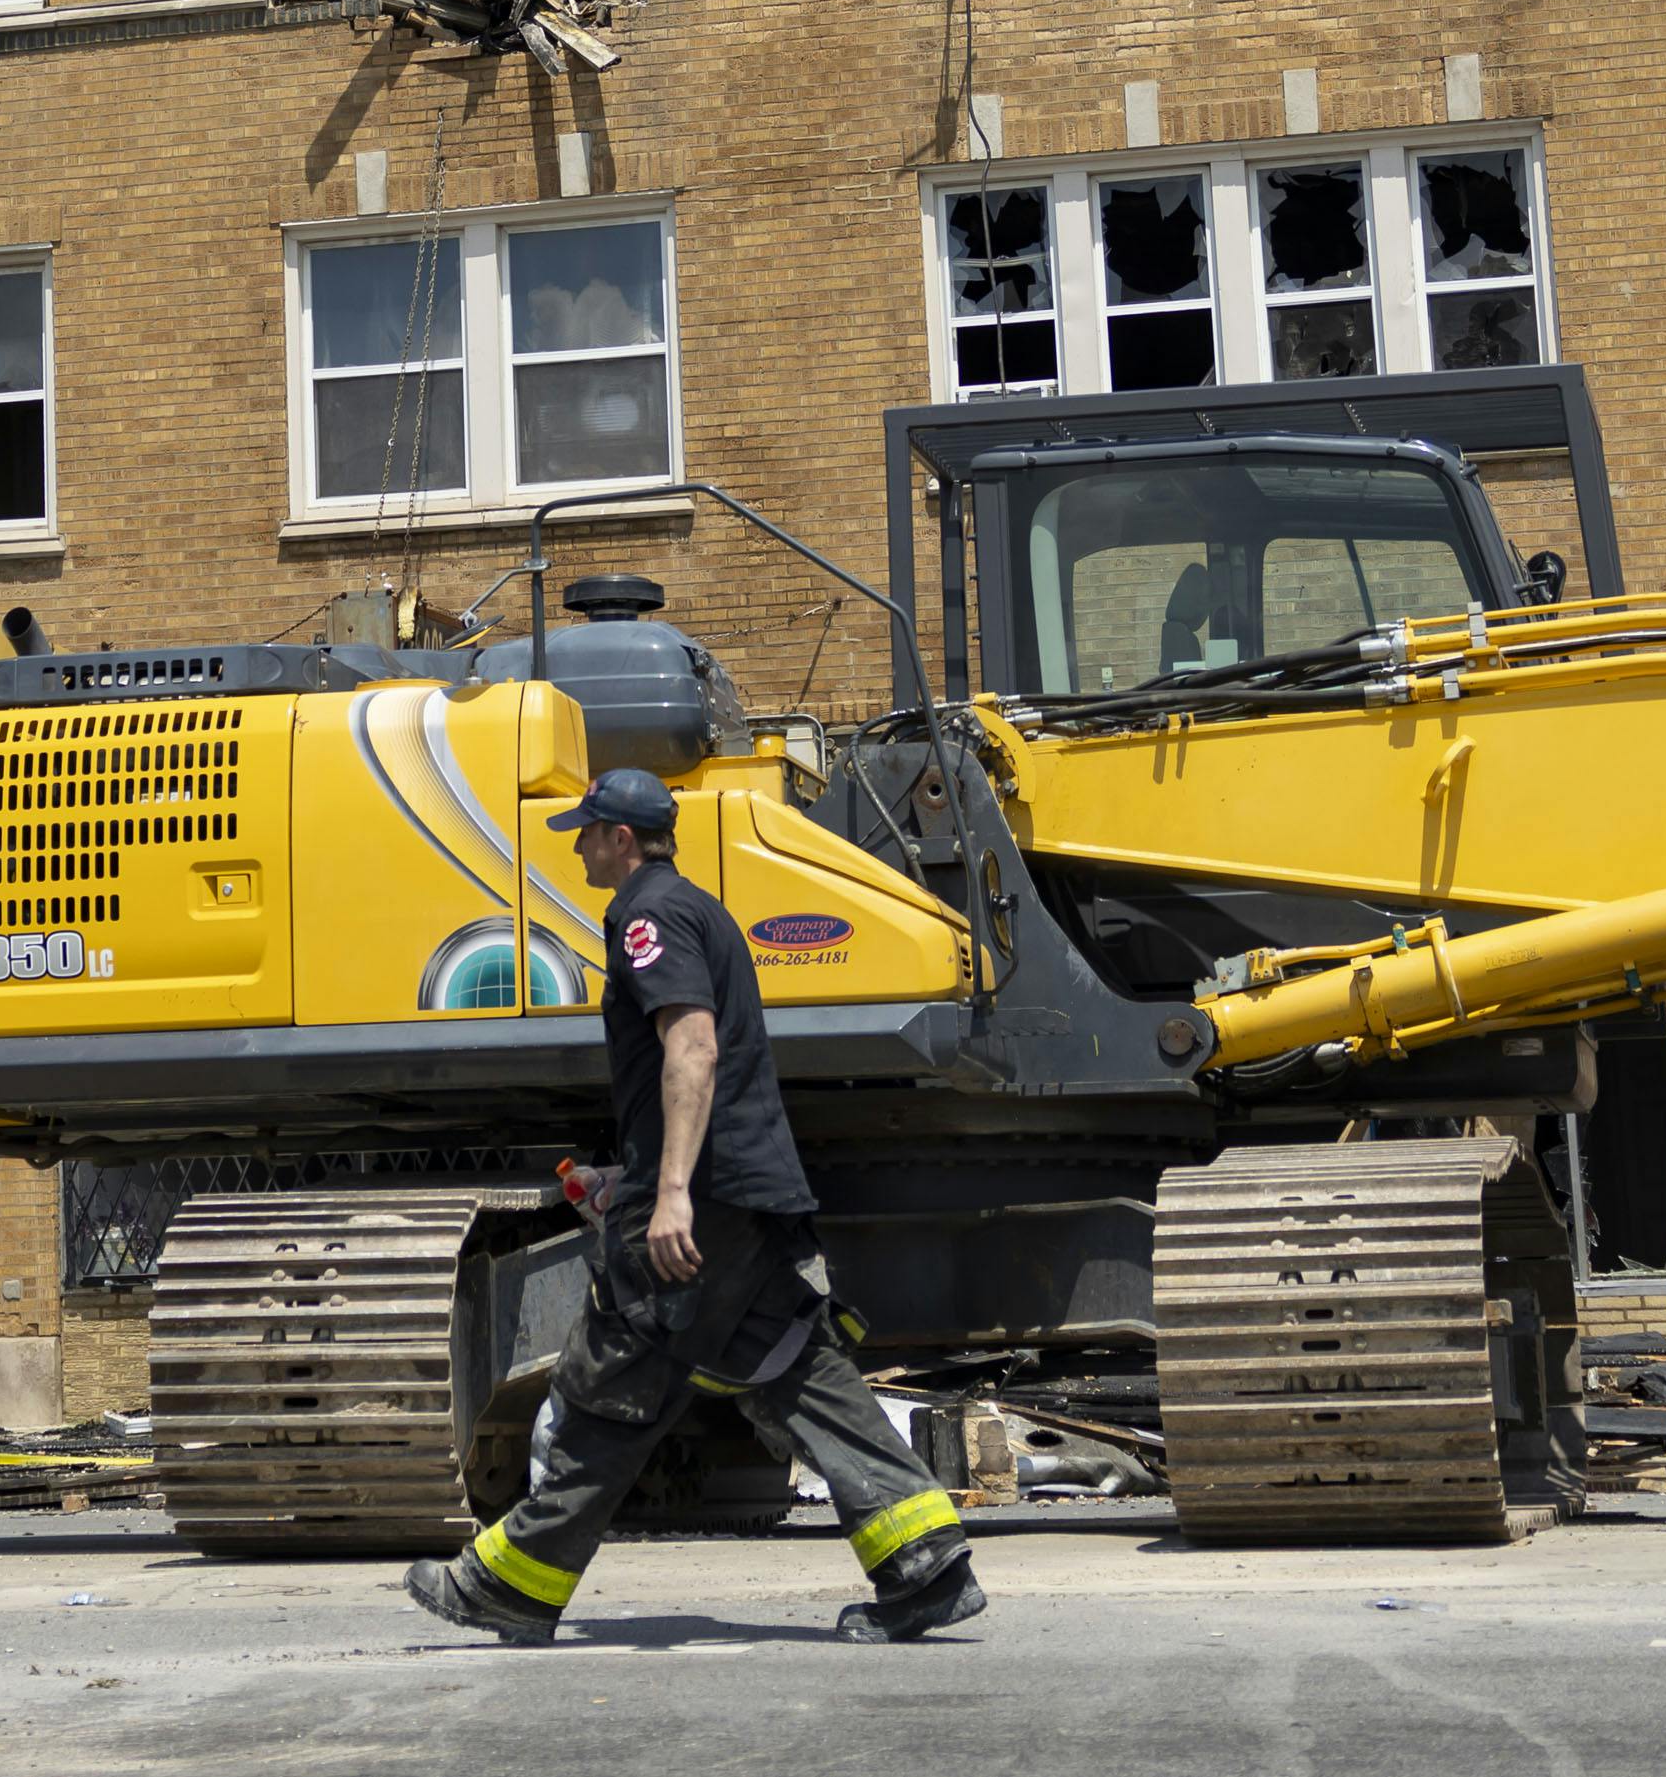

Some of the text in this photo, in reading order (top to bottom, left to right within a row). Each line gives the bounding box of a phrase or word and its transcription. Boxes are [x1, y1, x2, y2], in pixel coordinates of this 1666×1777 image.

[764, 919, 838, 932] Company
[772, 929, 828, 942] Wrench
[88, 949, 114, 978] LC
[754, 951, 849, 967] 866-262-4181
